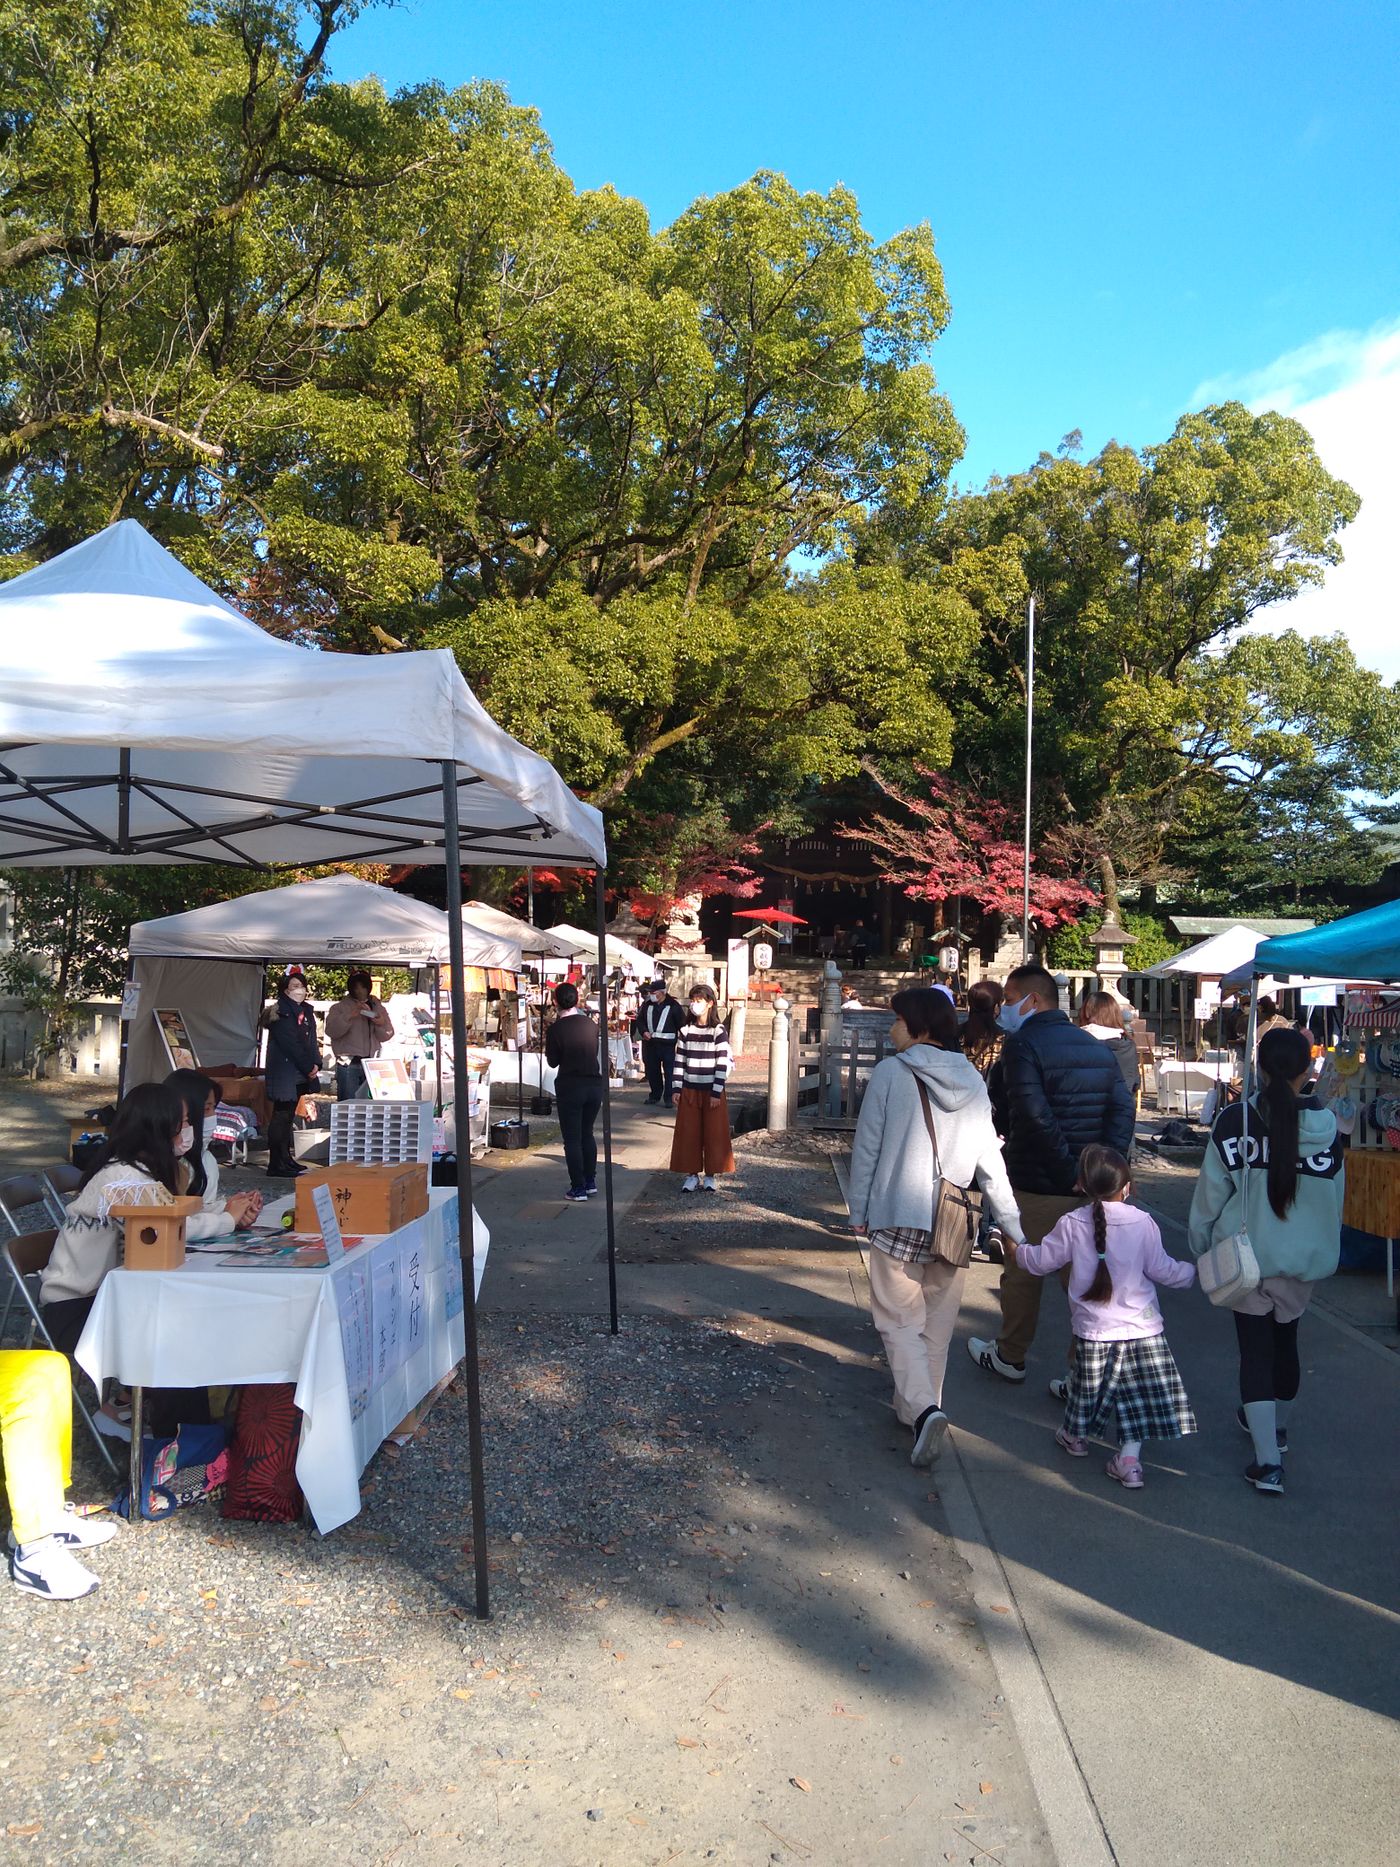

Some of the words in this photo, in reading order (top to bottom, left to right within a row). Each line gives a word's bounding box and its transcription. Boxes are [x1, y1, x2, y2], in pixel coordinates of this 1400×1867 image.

[335, 1187, 353, 1228] 神くじ
[408, 1252, 421, 1342] 受付
